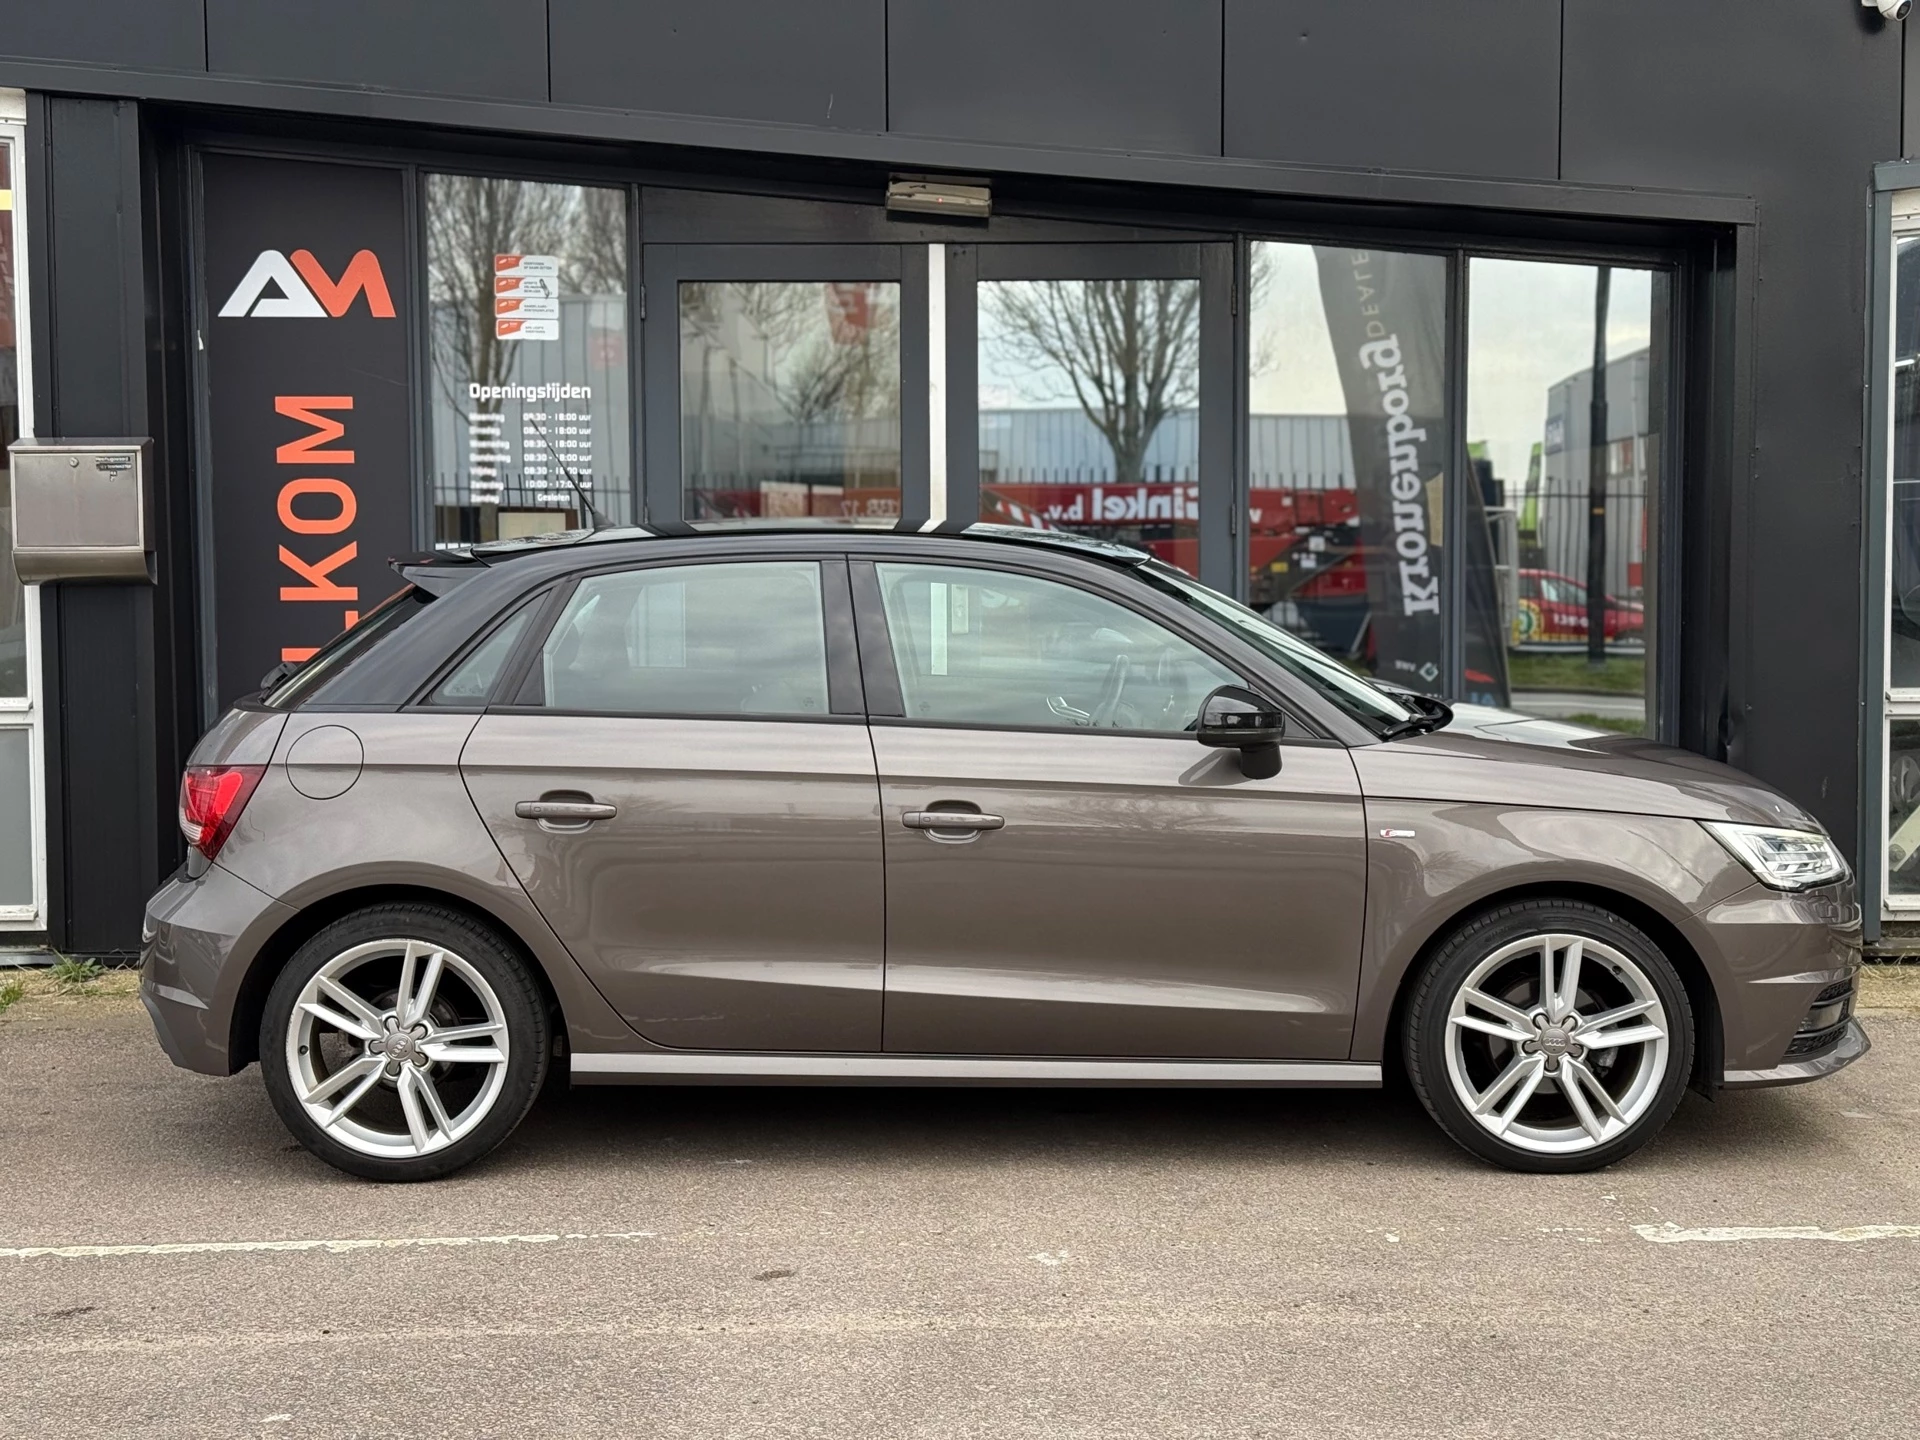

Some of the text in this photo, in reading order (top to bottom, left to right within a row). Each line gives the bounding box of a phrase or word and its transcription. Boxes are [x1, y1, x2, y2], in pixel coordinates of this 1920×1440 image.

[217, 249, 397, 318] AM
[469, 382, 592, 402] Openingstijden
[556, 467, 577, 475] 1800
[556, 481, 577, 489] 17:0
[537, 493, 570, 502] Gesloten
